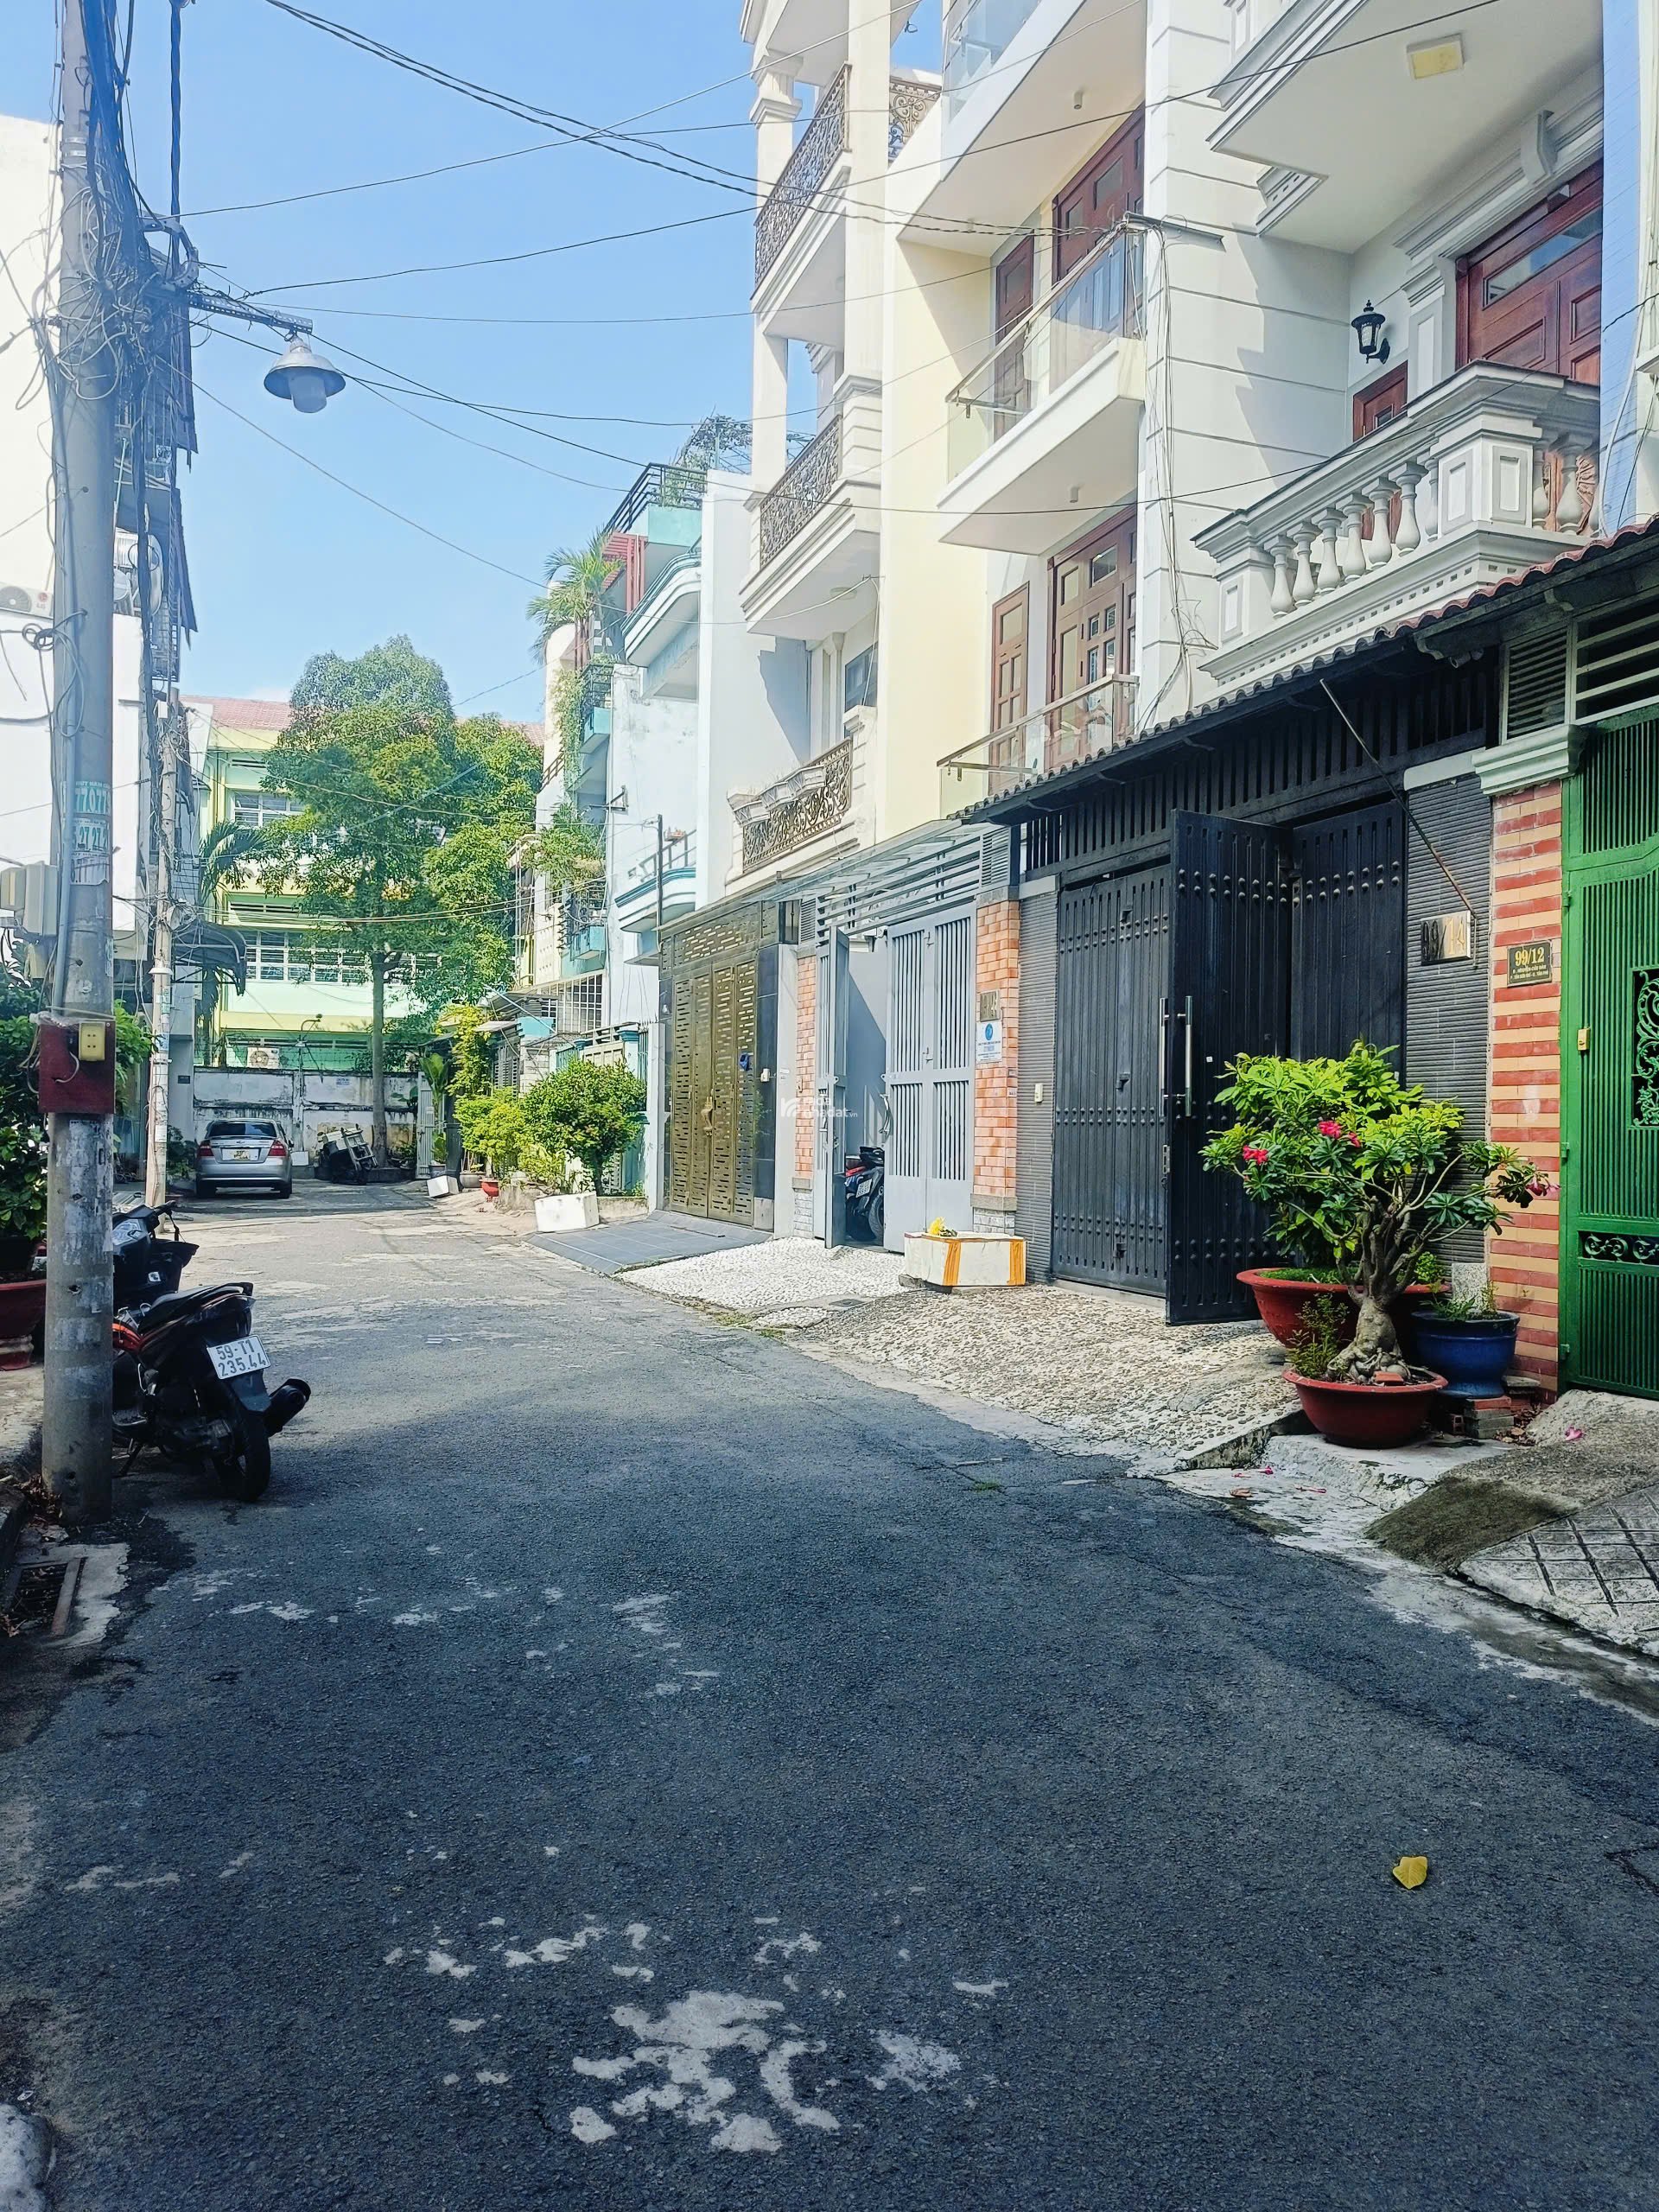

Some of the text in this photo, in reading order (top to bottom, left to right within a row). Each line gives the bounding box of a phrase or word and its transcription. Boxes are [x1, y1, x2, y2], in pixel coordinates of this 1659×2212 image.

[1515, 947, 1545, 966] 99/12
[215, 1339, 255, 1360] 59-T1
[218, 1352, 266, 1376] 235.44
